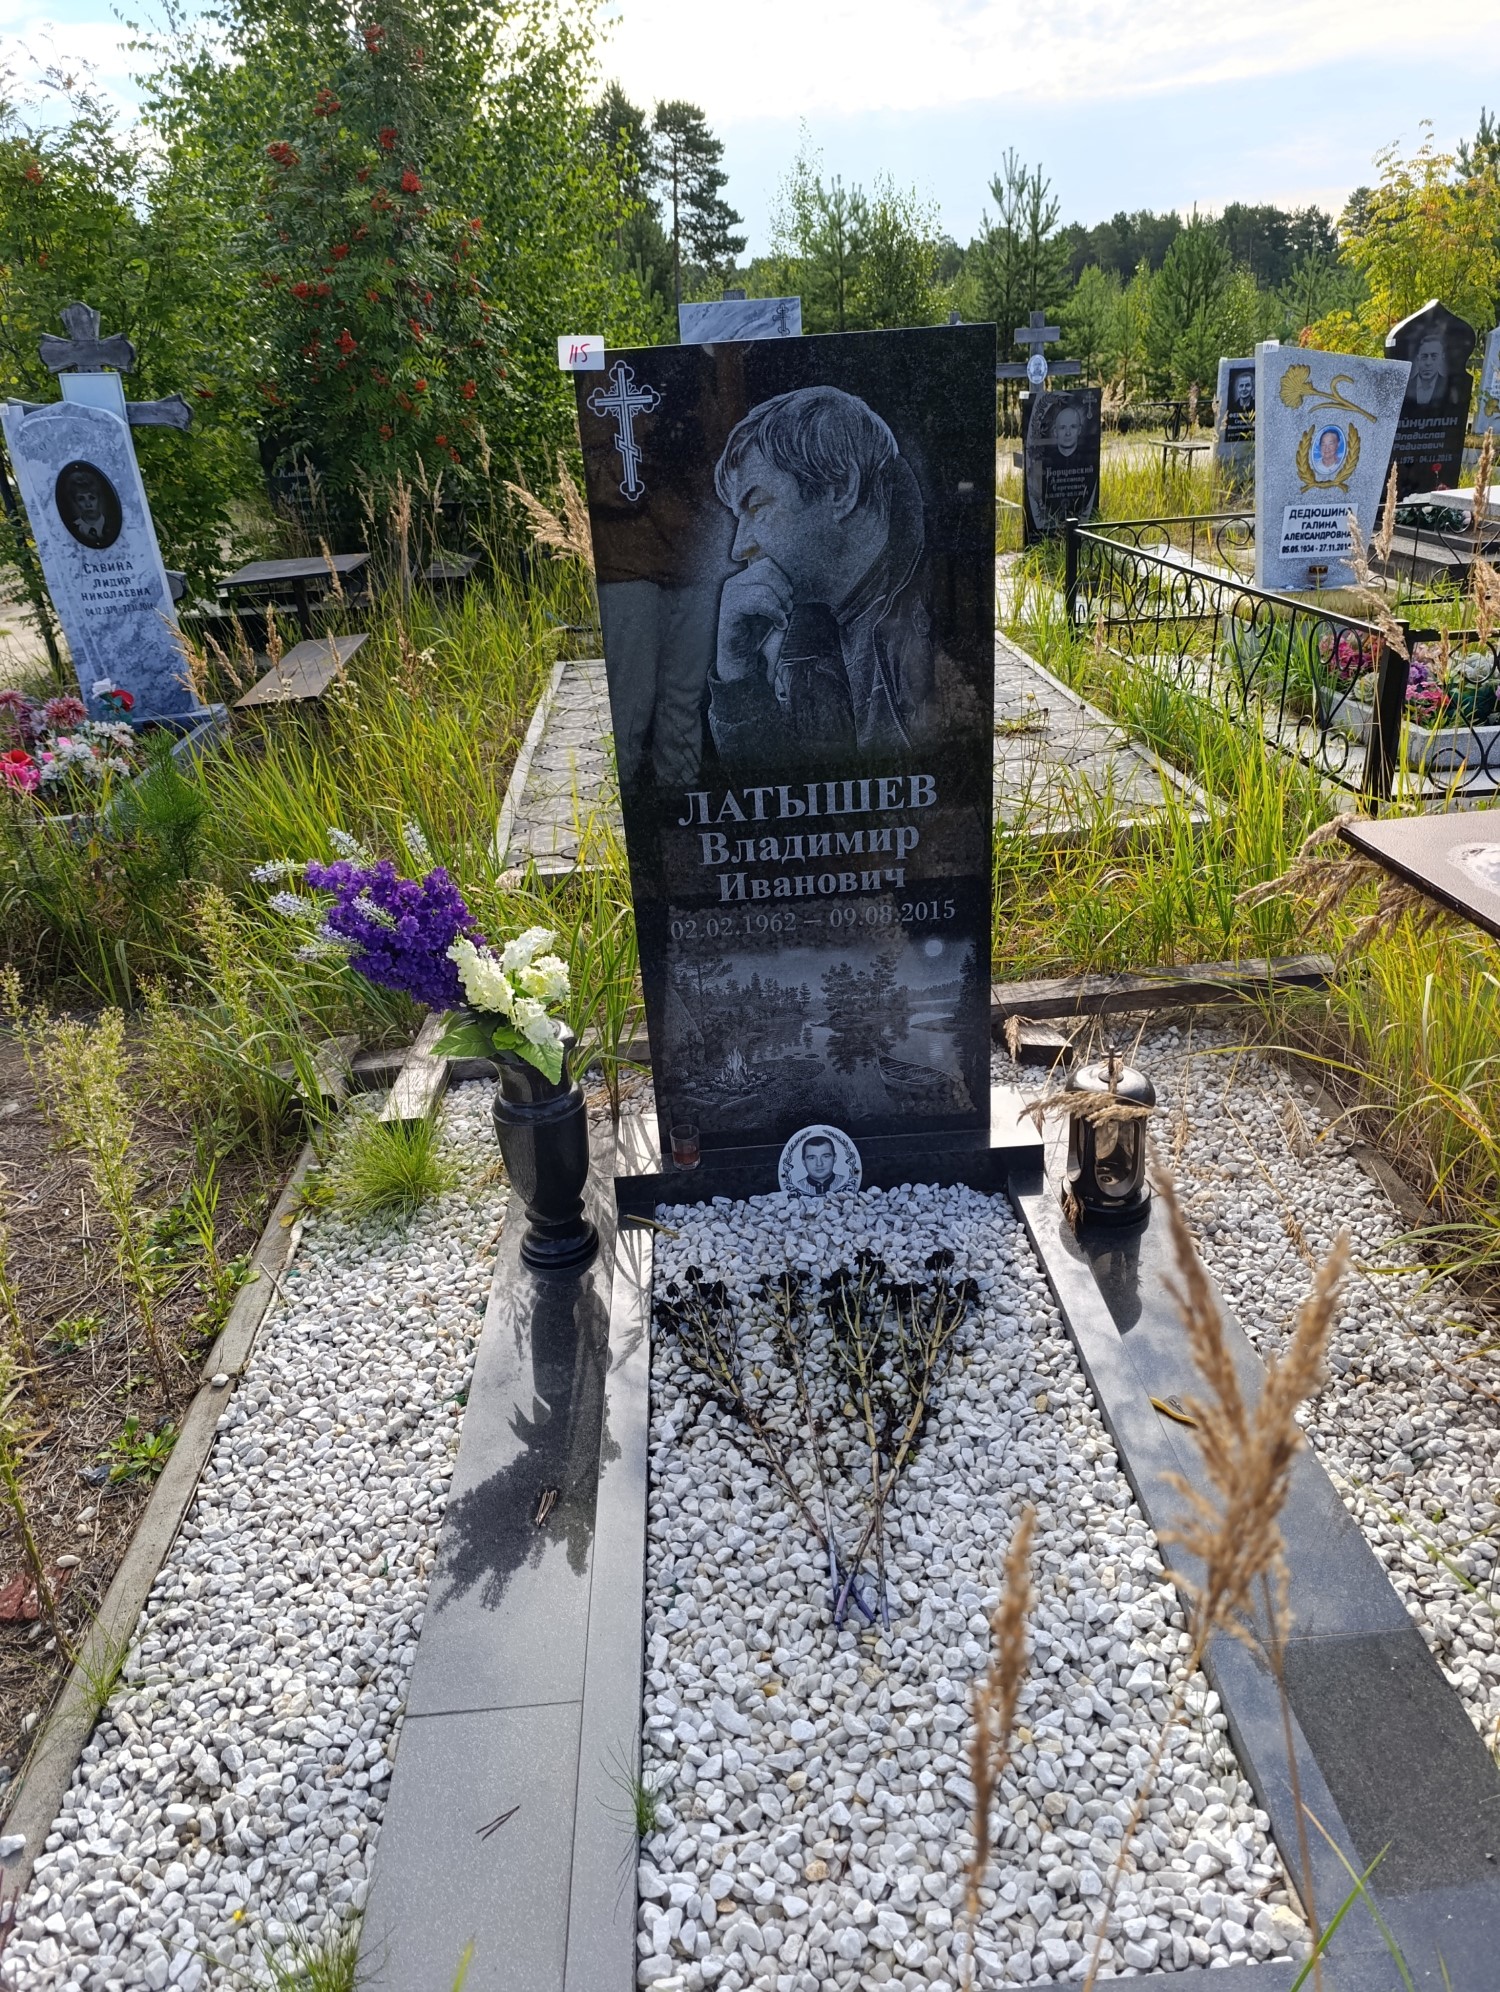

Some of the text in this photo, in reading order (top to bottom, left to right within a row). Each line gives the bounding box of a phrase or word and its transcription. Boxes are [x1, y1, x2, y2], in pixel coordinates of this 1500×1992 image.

[568, 343, 591, 364] 115
[1396, 417, 1458, 430] йнуллин
[1284, 531, 1352, 541] АЛЕКСАНДРОВНА
[1301, 521, 1338, 529] ГАЛИНА
[678, 774, 937, 826] ЛАТЫШЕВ
[697, 825, 920, 866] Владимир
[716, 868, 906, 901] Иванович
[670, 912, 796, 940] 02.02.1962
[829, 899, 956, 928] 09.08.2015
